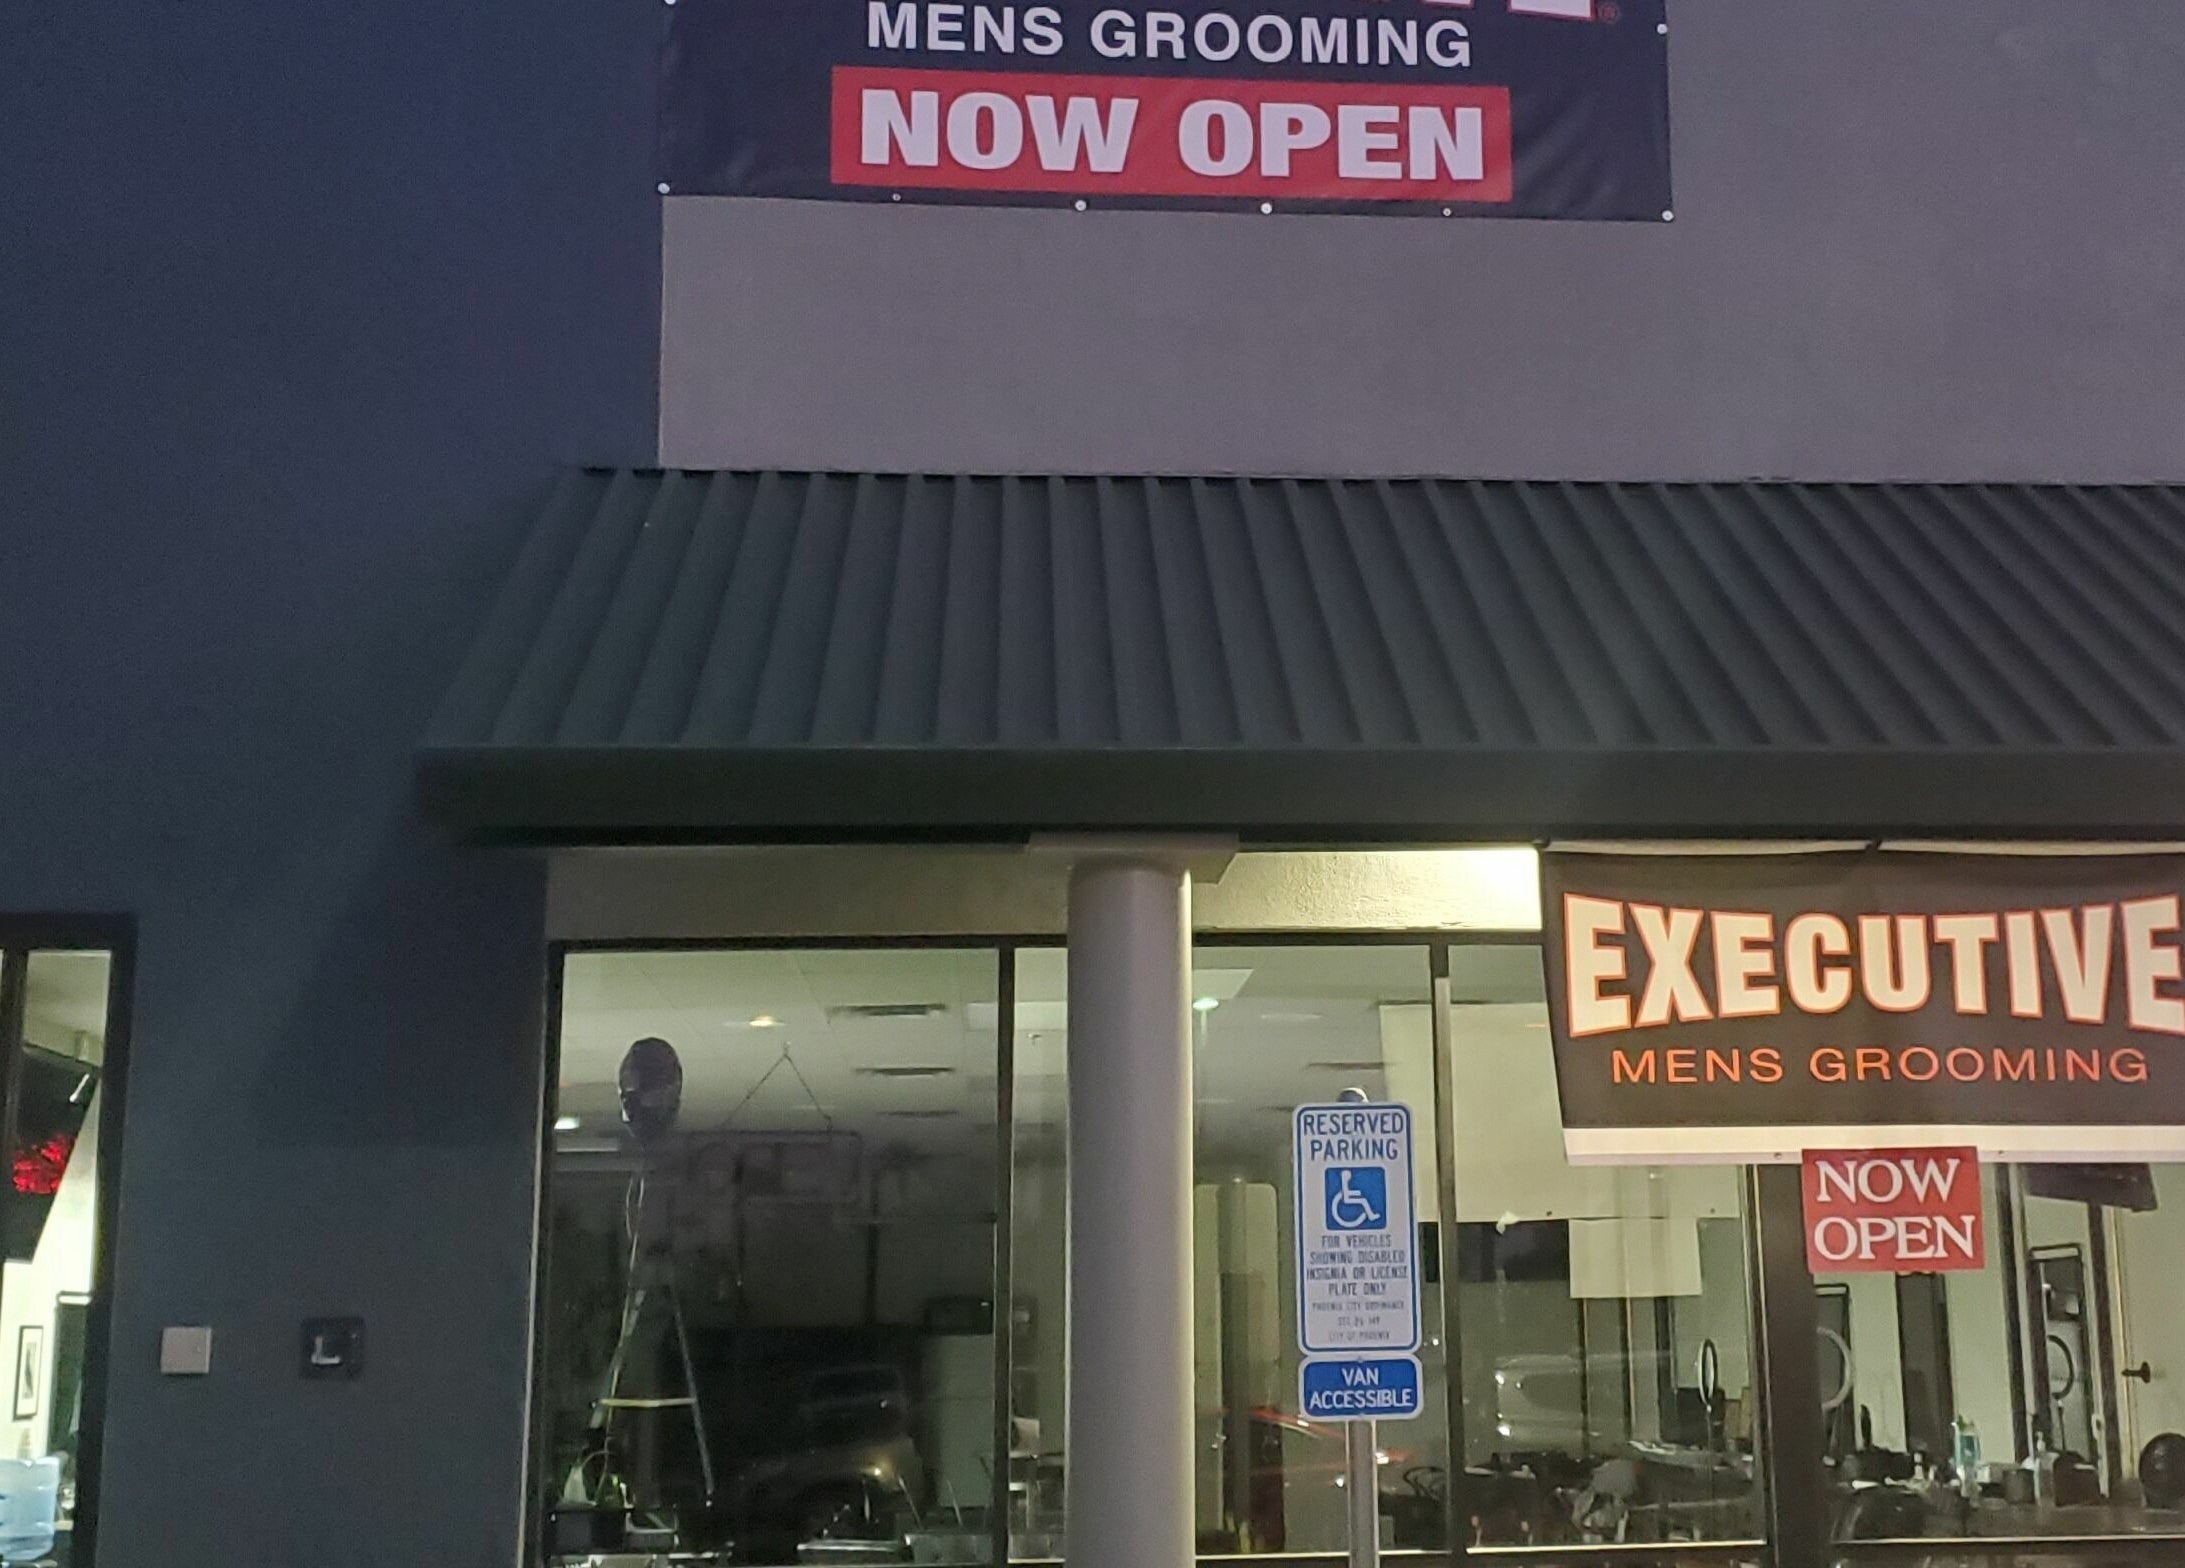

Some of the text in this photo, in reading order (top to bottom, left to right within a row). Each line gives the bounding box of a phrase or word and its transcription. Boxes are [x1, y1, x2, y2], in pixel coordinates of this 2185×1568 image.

[868, 1, 1471, 67] MENS GROOMING
[861, 89, 1484, 180] NOW OPEN
[1564, 892, 2185, 1037] EXECUTIVE
[1612, 1047, 2148, 1083] MENS GROOMING
[1303, 1113, 1404, 1136] RESERVED
[1310, 1139, 1399, 1161] PARKING
[1815, 1157, 1960, 1205] NOW
[1321, 1234, 1392, 1248] FOR VEHICLES
[1813, 1214, 1976, 1262] OPEN
[1309, 1250, 1405, 1265] SHOWING DISABLED
[1353, 1266, 1365, 1280] OR
[1371, 1265, 1408, 1280] LICENSE
[1328, 1282, 1386, 1296] PLATE ONLY
[1341, 1367, 1379, 1386] VAN
[1309, 1388, 1414, 1410] ACCESSIBLE
